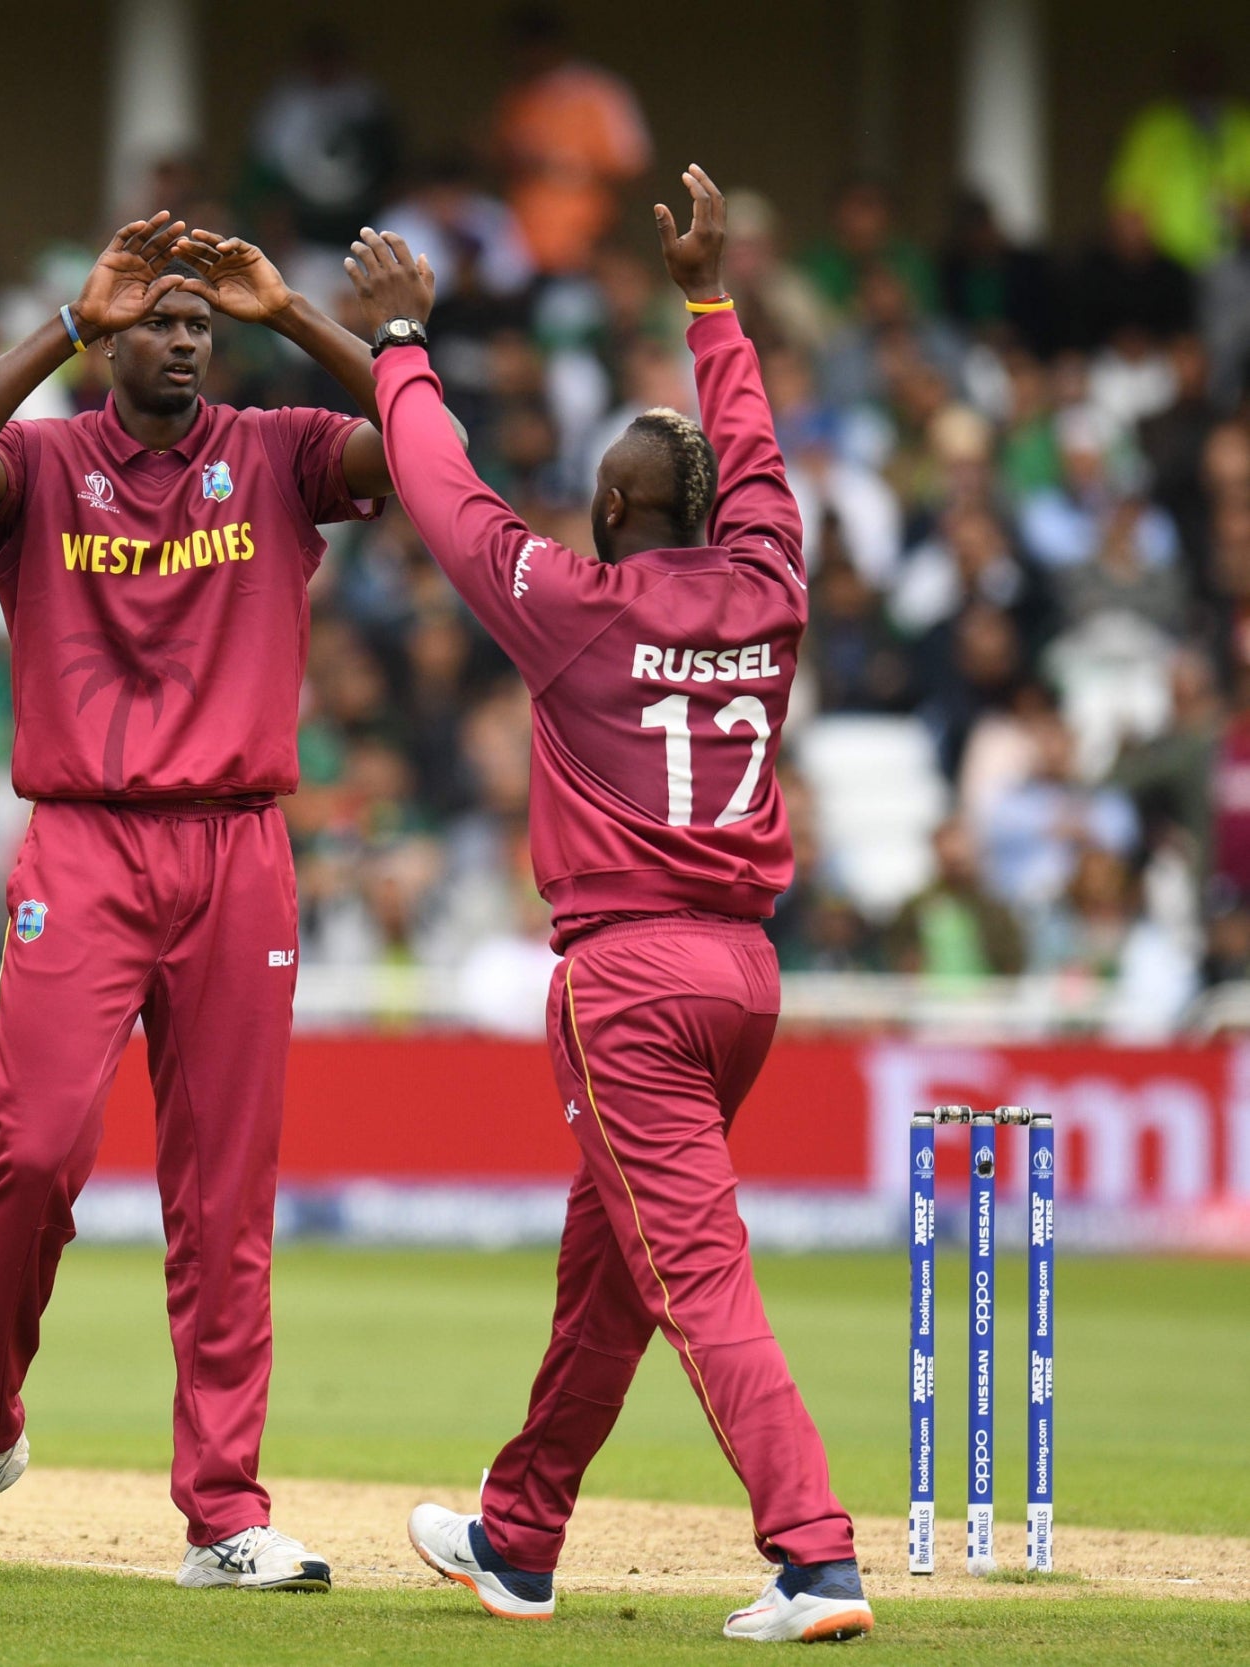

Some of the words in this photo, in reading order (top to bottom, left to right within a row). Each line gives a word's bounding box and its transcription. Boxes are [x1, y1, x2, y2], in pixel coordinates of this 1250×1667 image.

[61, 532, 151, 576] WEST
[158, 522, 255, 576] INDIES
[631, 643, 780, 683] RUSSEL
[640, 694, 772, 827] 12
[268, 949, 295, 967] BLK
[915, 1191, 927, 1246] MRF
[979, 1191, 990, 1257] NISSAN
[1032, 1191, 1045, 1247] MRF
[1045, 1199, 1054, 1240] TYRES
[919, 1260, 931, 1335] Booking.com
[1037, 1261, 1049, 1336] Booking.com
[913, 1349, 926, 1403] MRF
[978, 1350, 989, 1415] NISSAN
[1032, 1350, 1044, 1405] MRF
[1045, 1357, 1053, 1399] TYRES
[918, 1417, 930, 1492] Booking.com
[1036, 1419, 1049, 1494] Booking.com
[978, 1511, 989, 1556] AY-NICOLLS
